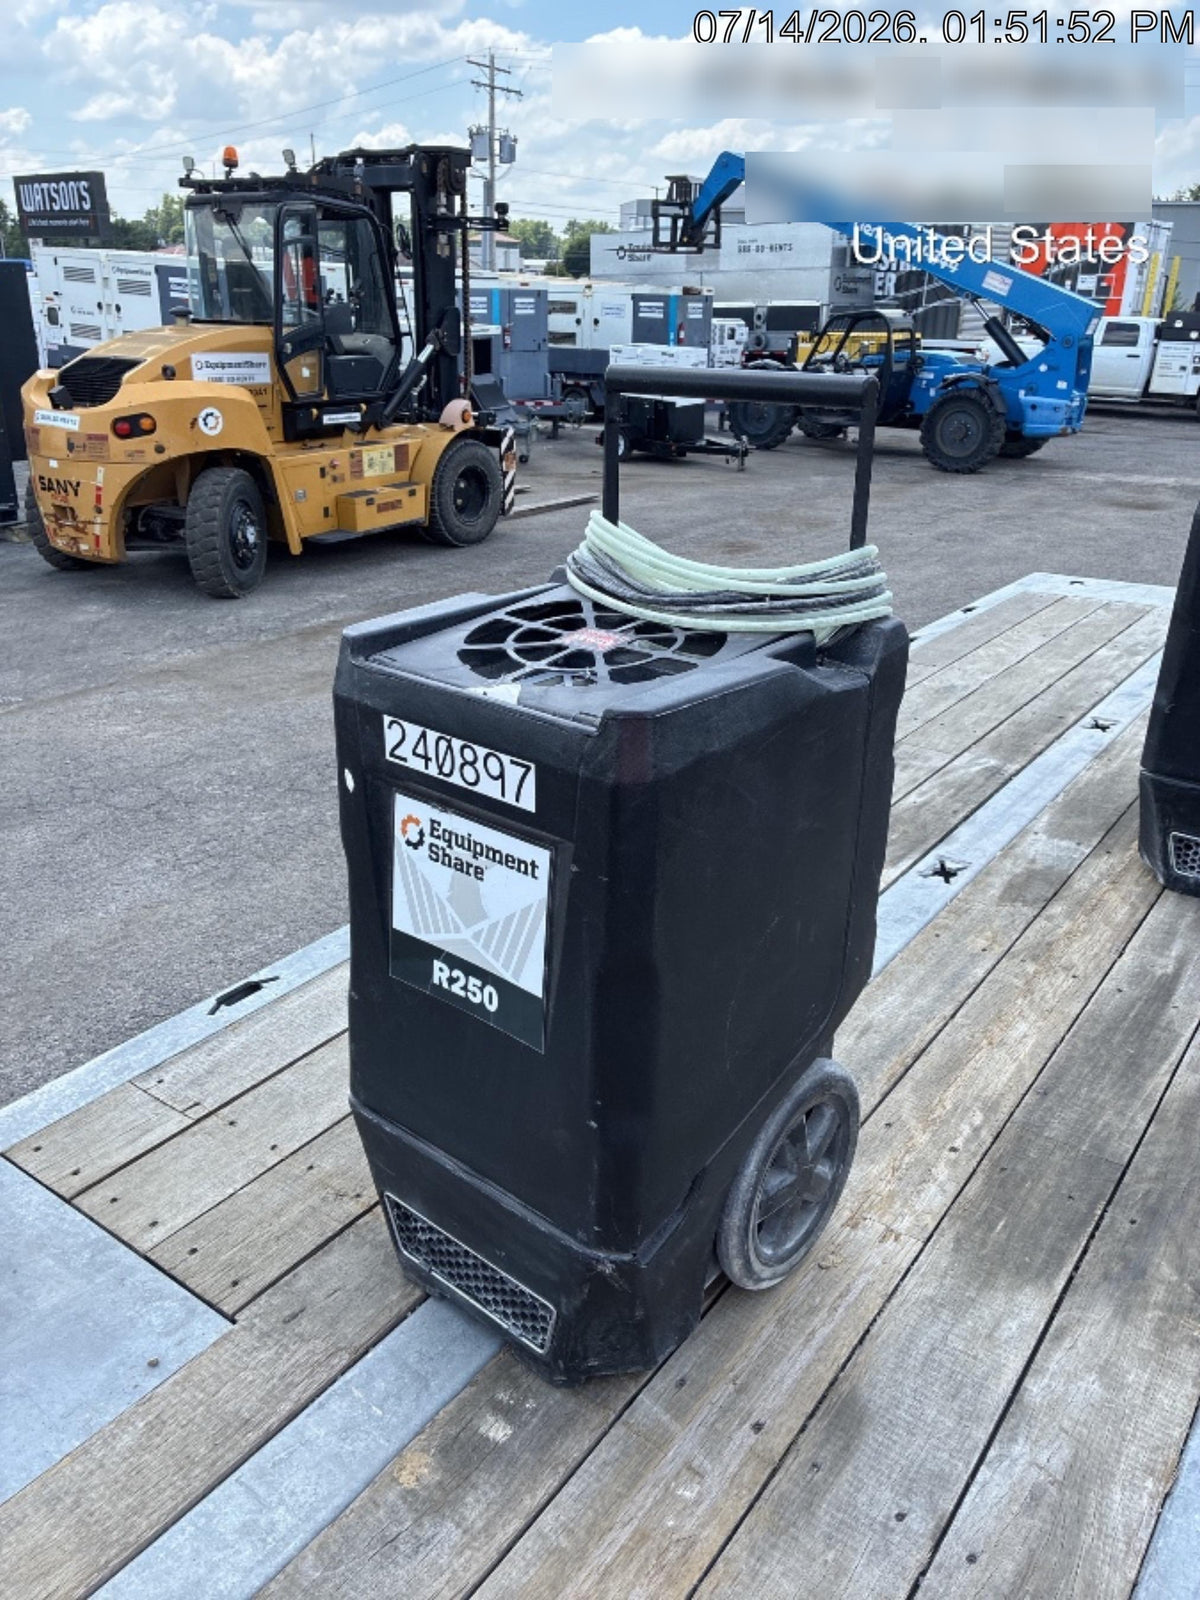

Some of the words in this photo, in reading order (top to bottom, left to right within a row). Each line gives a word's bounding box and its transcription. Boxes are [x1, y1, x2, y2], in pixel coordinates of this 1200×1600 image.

[38, 474, 80, 497] SANY
[387, 719, 533, 804] 240897
[427, 842, 485, 882] Share
[428, 818, 540, 881] Equipment
[432, 959, 499, 1013] R250
